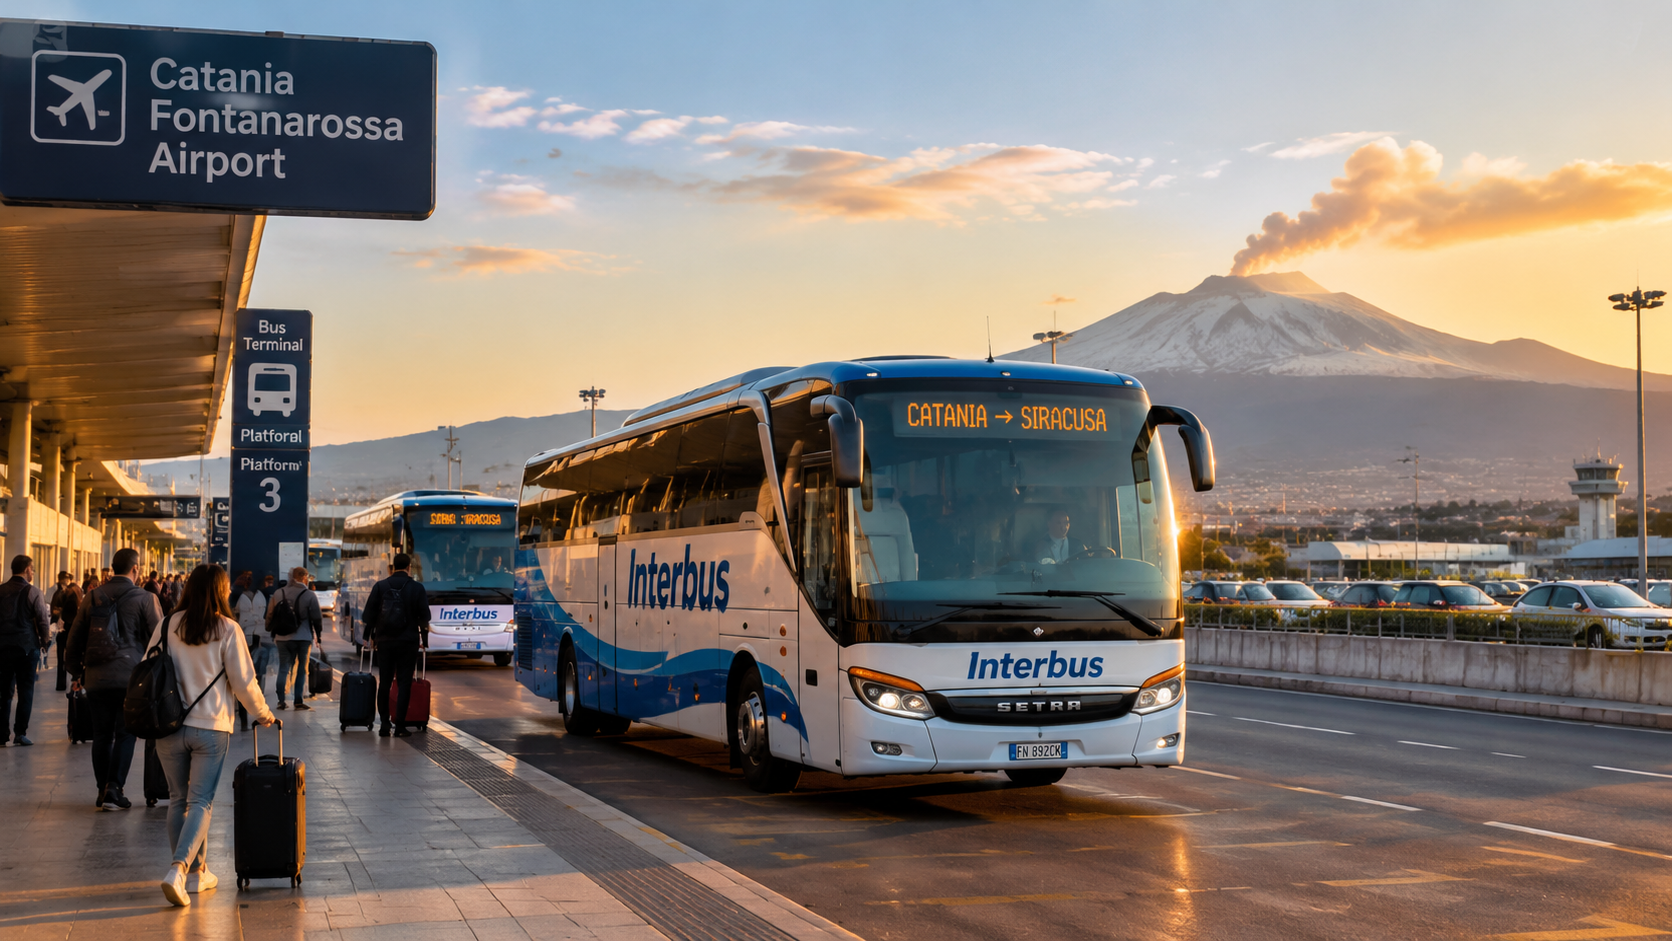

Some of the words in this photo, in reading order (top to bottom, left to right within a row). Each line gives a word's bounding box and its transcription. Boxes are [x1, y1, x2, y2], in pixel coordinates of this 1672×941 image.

[150, 57, 294, 95] Catania
[150, 98, 404, 141] Fontanarossa
[148, 142, 286, 183] Airport
[258, 319, 286, 334] Bus
[243, 337, 303, 351] Terminal
[907, 402, 988, 428] CATANIA
[1021, 406, 1107, 432] SIRACUSA
[258, 476, 281, 513] 3
[628, 543, 730, 613] Interbus
[439, 607, 498, 620] Interbus
[967, 650, 1104, 680] Interbus
[997, 701, 1081, 712] SETRA
[1017, 745, 1029, 758] FN
[1032, 744, 1061, 757] 892CK
